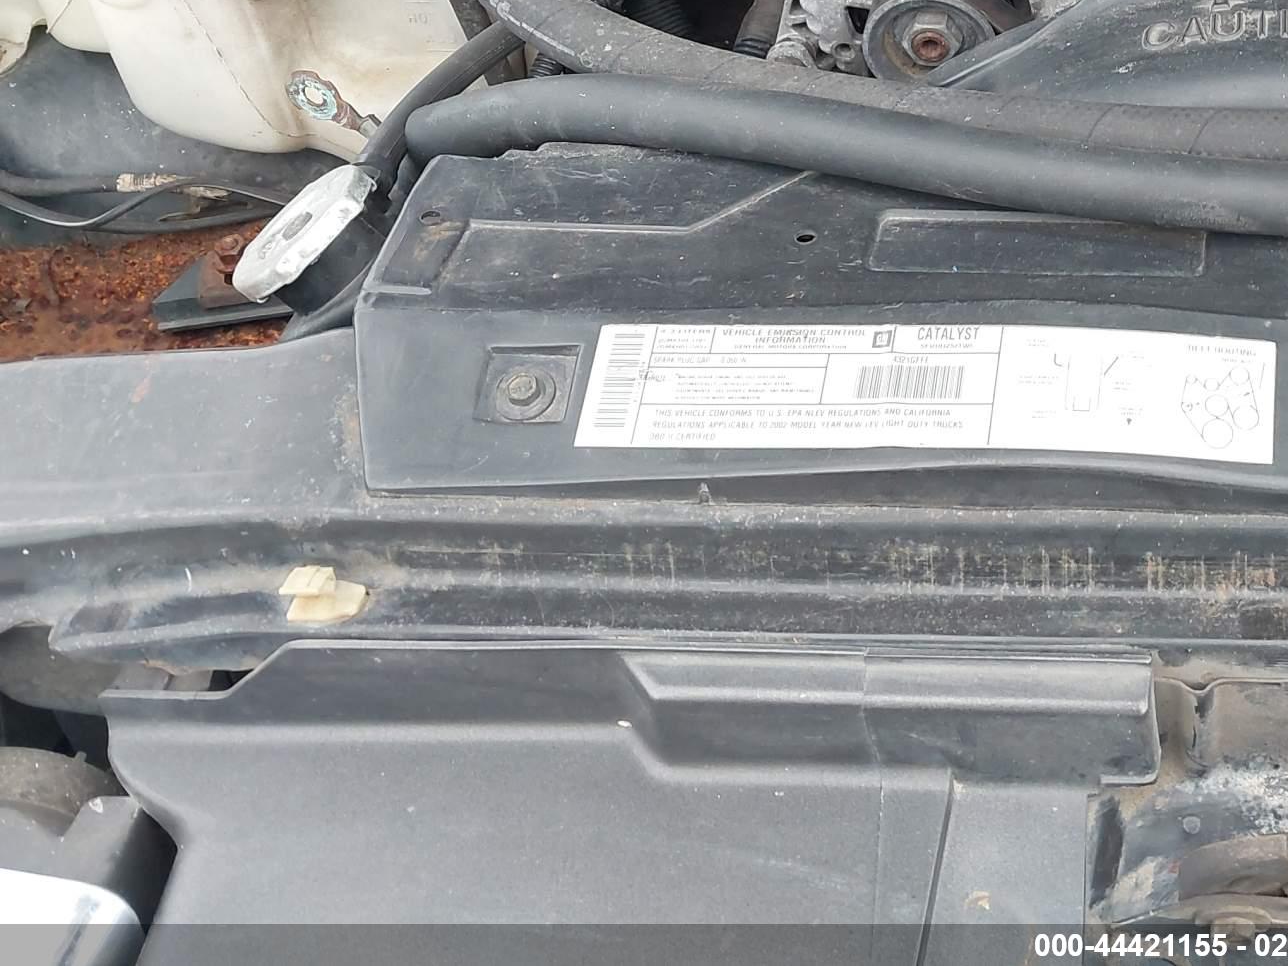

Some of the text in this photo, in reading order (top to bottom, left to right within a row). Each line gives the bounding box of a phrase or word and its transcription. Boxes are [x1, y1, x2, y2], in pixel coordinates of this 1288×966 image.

[820, 329, 866, 337] CONTROL
[918, 327, 980, 340] CATALYST
[755, 336, 826, 344] INFORMATION
[655, 409, 672, 417] THIS
[674, 409, 706, 417] VEHICLE
[708, 409, 753, 417] CONFORMS
[756, 409, 765, 417] TO
[787, 409, 803, 417] EPA
[805, 409, 825, 417] NLEV
[827, 409, 882, 417] REGULATIONS
[884, 408, 901, 416] AND
[903, 409, 951, 417] CALIFORNIA
[882, 419, 904, 427] LIGHT
[675, 433, 716, 441] CERTIFIED
